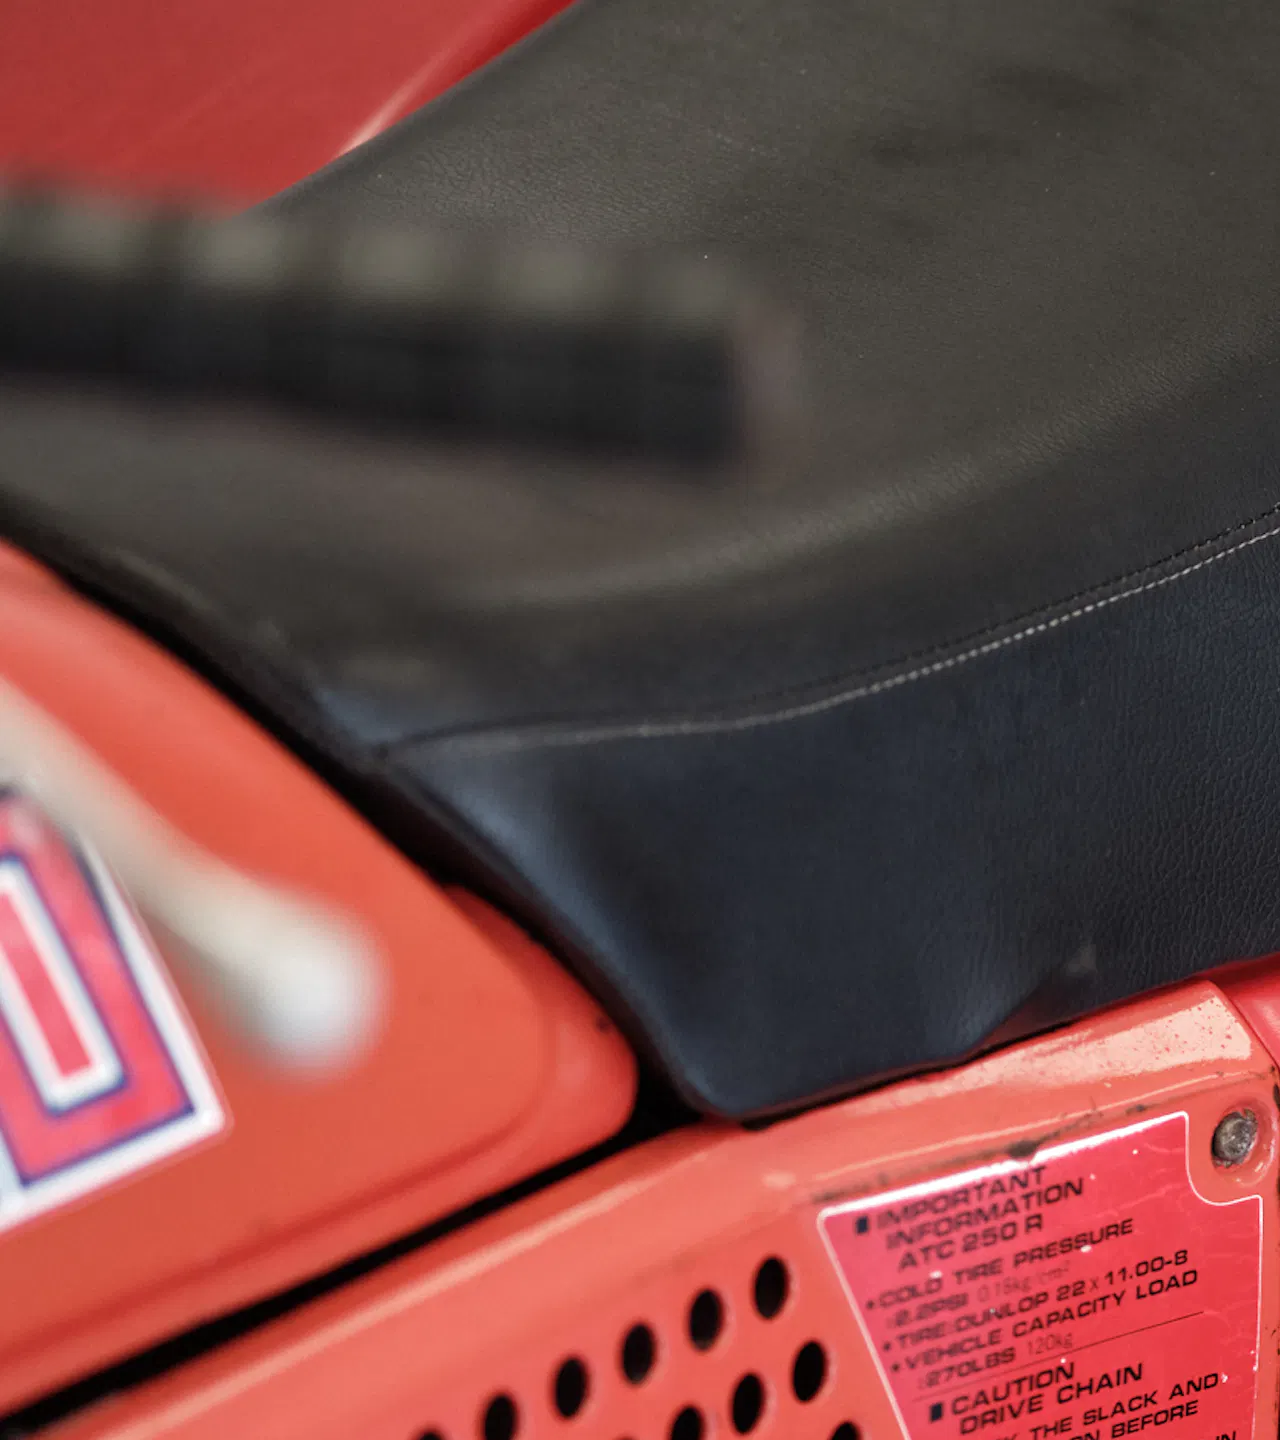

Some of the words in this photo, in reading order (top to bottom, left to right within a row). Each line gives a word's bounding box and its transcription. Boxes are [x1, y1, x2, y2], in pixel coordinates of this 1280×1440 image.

[877, 1165, 1046, 1229] IMPORTANT
[887, 1178, 1083, 1250] INFORMATION
[878, 1277, 943, 1308] COLD
[954, 1258, 1005, 1285] TIRE
[1012, 1218, 1134, 1268] PRESSURE
[899, 1239, 954, 1271] ATC
[961, 1222, 1018, 1253] 250
[1025, 1213, 1044, 1234] R
[1056, 1279, 1086, 1302] 22
[1103, 1249, 1189, 1285] 11.00-8
[904, 1328, 1002, 1370] VEHICLE
[1012, 1289, 1126, 1339] CAPACITY
[1135, 1269, 1198, 1300] LOAD
[951, 1361, 1075, 1416] CAUTION
[959, 1393, 1043, 1436] DRIVE
[1056, 1362, 1143, 1405] CHAIN
[1083, 1390, 1158, 1425] SLACK
[1168, 1372, 1220, 1400] AND
[1110, 1399, 1200, 1439] BEFORE
